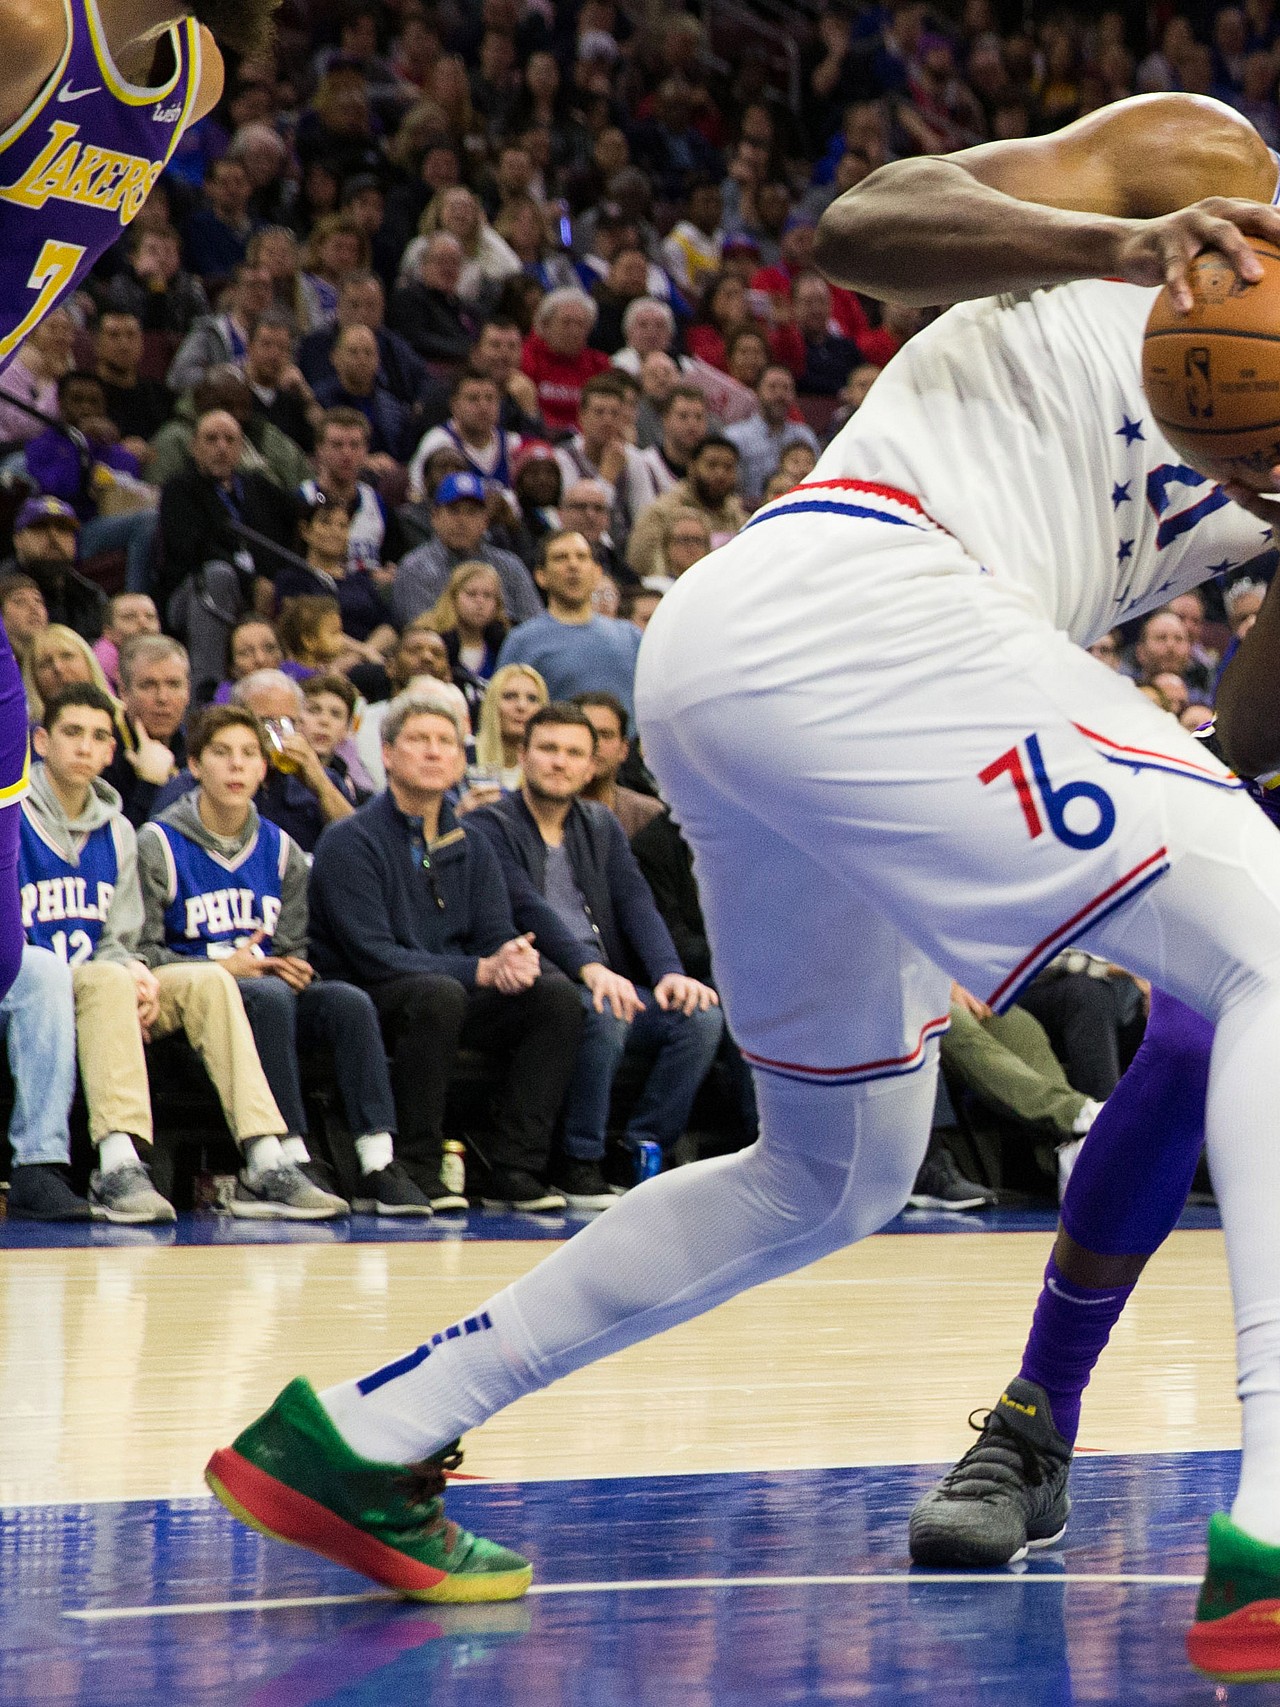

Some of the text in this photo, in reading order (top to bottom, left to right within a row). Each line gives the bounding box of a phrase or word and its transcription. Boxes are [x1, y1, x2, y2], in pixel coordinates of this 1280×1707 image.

[152, 101, 182, 123] wish
[0, 120, 164, 226] LAKERS
[0, 238, 88, 362] 7
[976, 732, 1117, 851] 76
[51, 929, 93, 968] 12
